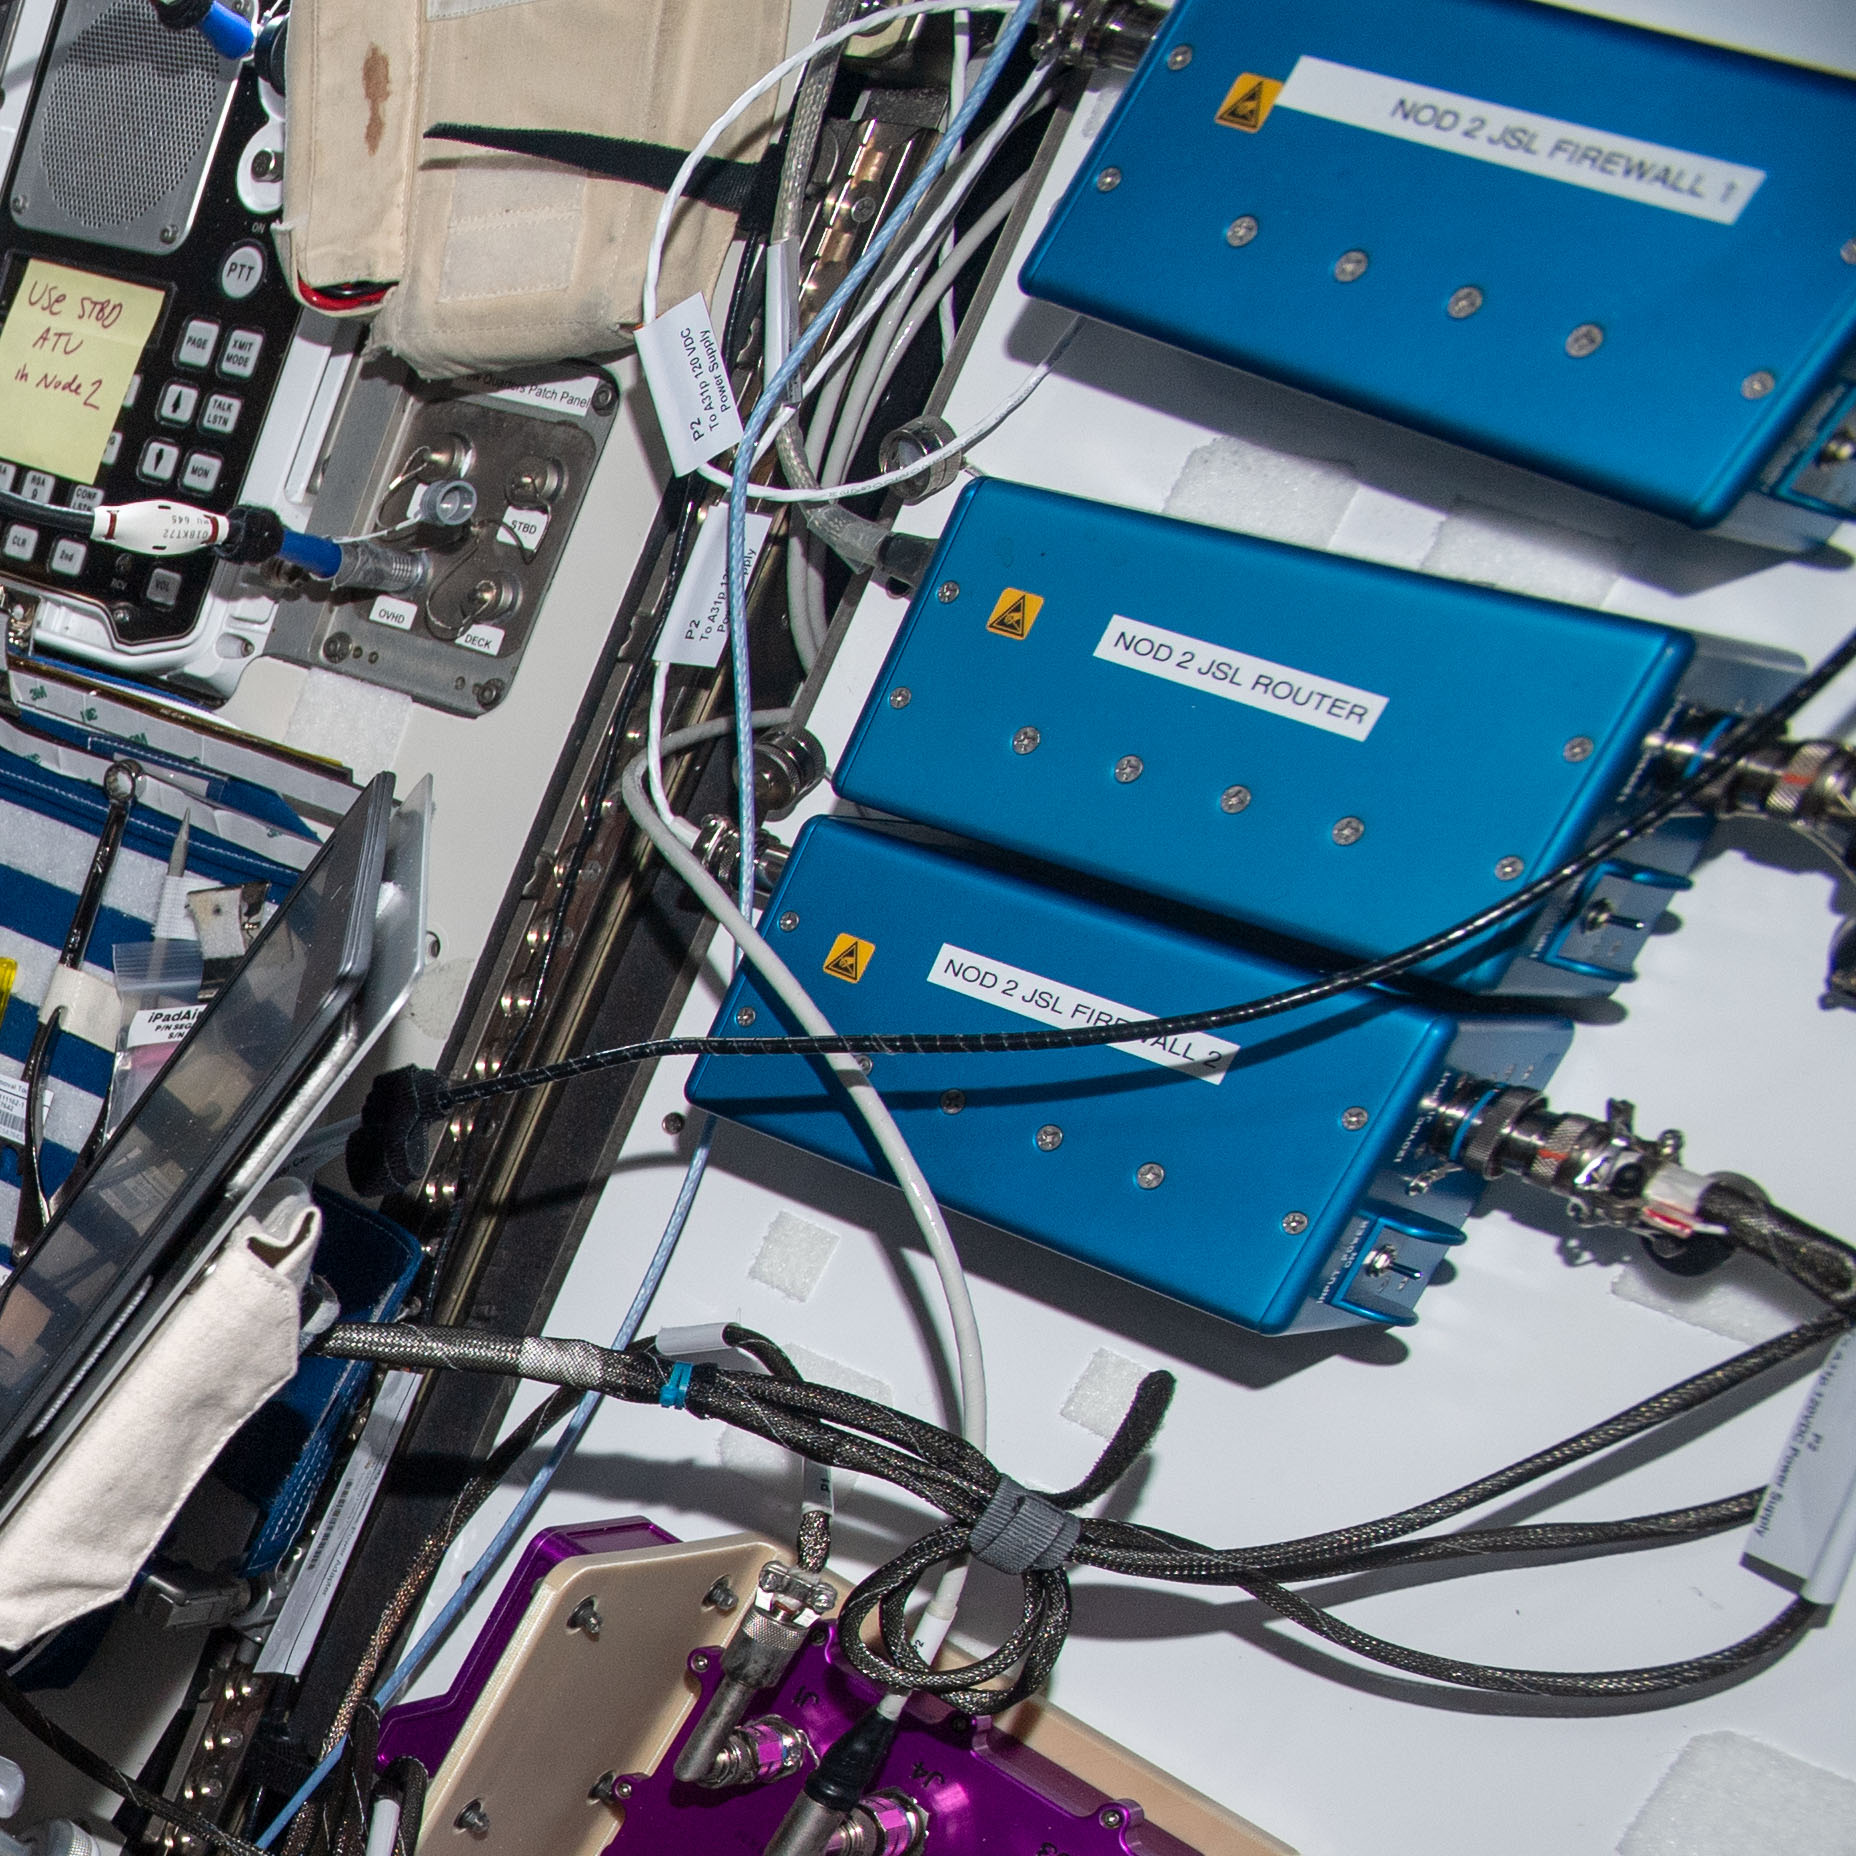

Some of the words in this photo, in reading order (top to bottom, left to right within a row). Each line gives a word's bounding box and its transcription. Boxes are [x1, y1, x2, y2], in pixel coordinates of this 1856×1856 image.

[1391, 98, 1460, 132] NOD
[1462, 116, 1486, 139] 2
[1487, 124, 1540, 155] JSL
[1548, 138, 1706, 199] FIREWALL
[226, 262, 255, 282] PTT
[32, 326, 84, 355] ATU
[186, 336, 208, 350] PAGE
[232, 338, 254, 352] XMIT
[681, 327, 698, 359] VDC
[699, 329, 722, 371] Supply
[226, 352, 250, 368] MODE
[690, 361, 704, 385] 120
[37, 373, 82, 396] Node
[83, 379, 103, 410] 2
[528, 384, 558, 404] Patch
[560, 391, 590, 410] Panel
[696, 384, 715, 416] A31p
[713, 372, 731, 412] Power
[212, 399, 233, 412] TALK
[207, 412, 229, 427] LSTN
[689, 417, 705, 443] P2
[708, 417, 719, 431] To
[191, 464, 210, 479] MON
[76, 487, 97, 500] CONF
[511, 520, 537, 534] STBD
[11, 534, 27, 548] CLR
[378, 608, 405, 624] OVHD
[699, 620, 713, 642] To
[709, 588, 726, 624] A31p
[685, 618, 701, 640] P2
[464, 634, 492, 649] DECK
[1114, 631, 1173, 663] NOD
[1176, 651, 1195, 670] 2
[1198, 659, 1243, 687] JSL
[1251, 674, 1369, 725] ROUTER
[29, 685, 48, 701] 3M
[943, 958, 998, 989] NOD
[1001, 979, 1019, 998] 2
[1022, 988, 1063, 1015] JSL
[1203, 1050, 1223, 1068] 2
[154, 1024, 171, 1032] P/N
[168, 1031, 185, 1039] S/N
[1316, 1270, 1340, 1304] INPUT
[1340, 1220, 1370, 1262] POWER
[1806, 1431, 1824, 1452] P2
[1775, 1445, 1801, 1488] Power
[1754, 1491, 1783, 1538] Supply
[791, 1685, 821, 1709] J1
[911, 1759, 946, 1789] J4
